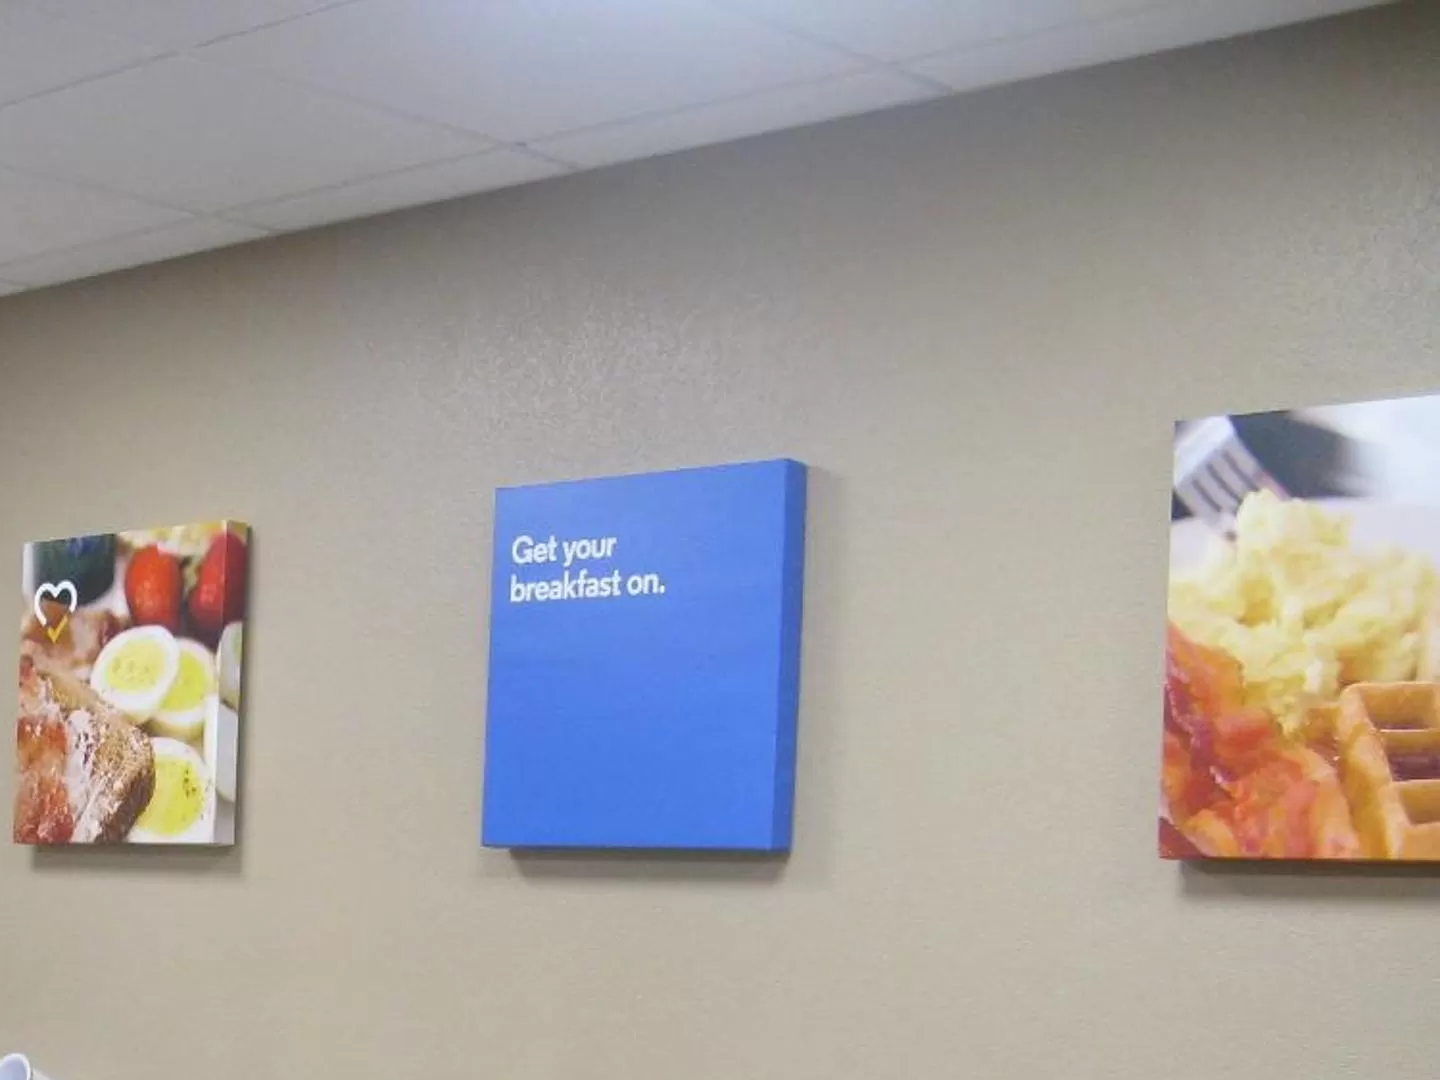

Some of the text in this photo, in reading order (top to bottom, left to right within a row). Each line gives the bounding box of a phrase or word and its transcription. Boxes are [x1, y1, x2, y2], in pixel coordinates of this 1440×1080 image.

[511, 535, 617, 567] Get your
[510, 569, 665, 602] breakfast on.
